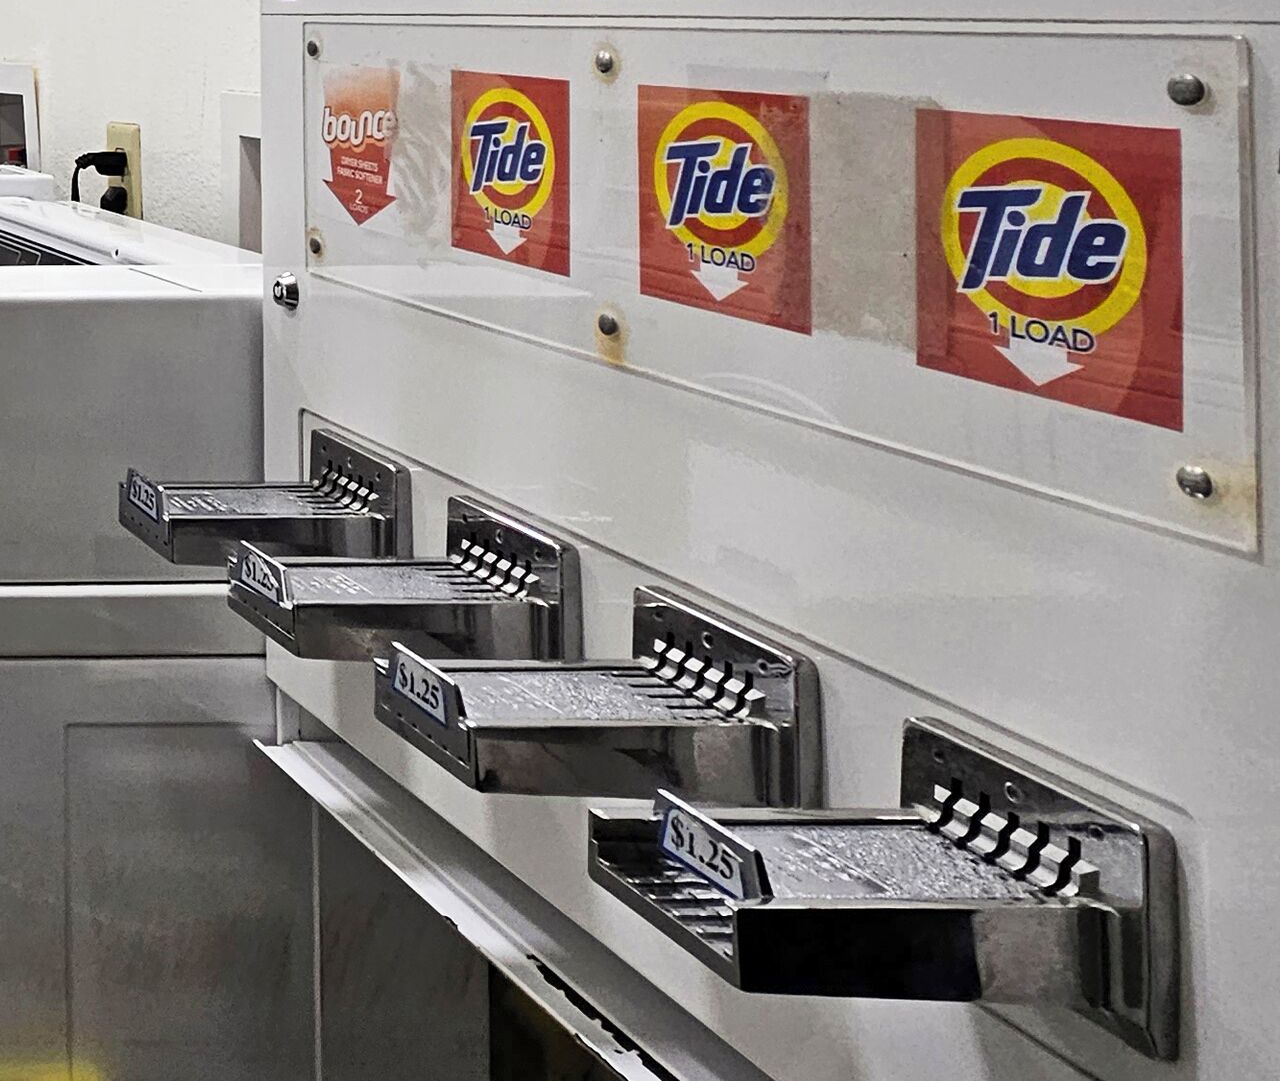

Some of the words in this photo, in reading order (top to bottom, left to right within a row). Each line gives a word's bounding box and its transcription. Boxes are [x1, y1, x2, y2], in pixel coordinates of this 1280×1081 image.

[469, 120, 547, 195] Tide
[355, 189, 363, 204] 2
[665, 141, 776, 230] Tide
[484, 206, 491, 221] 1
[494, 208, 532, 230] LOAD
[956, 186, 1129, 293] Tide
[687, 242, 695, 261] 1
[701, 248, 755, 273] LOAD
[989, 311, 999, 335] 1
[1010, 316, 1096, 353] LOAD
[131, 482, 156, 515] $1.25
[398, 662, 440, 710] $1.25
[670, 814, 737, 880] $1.25
